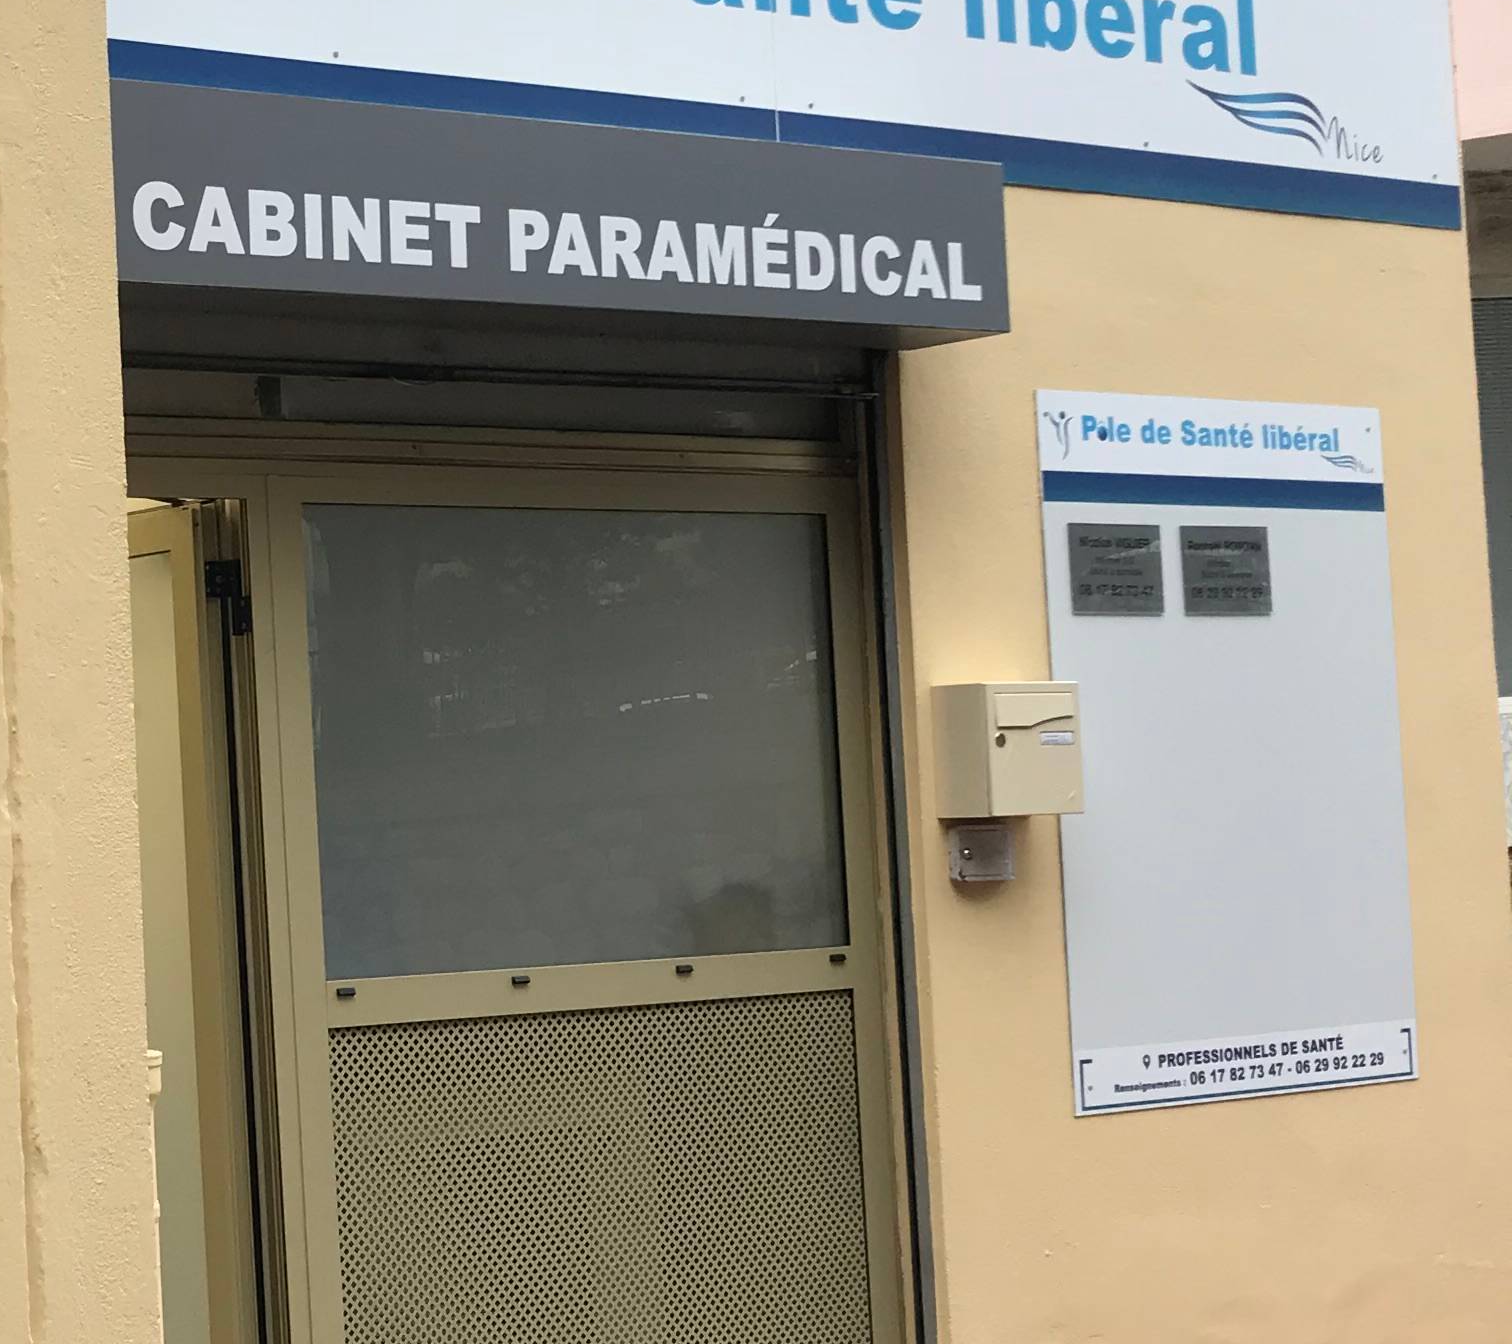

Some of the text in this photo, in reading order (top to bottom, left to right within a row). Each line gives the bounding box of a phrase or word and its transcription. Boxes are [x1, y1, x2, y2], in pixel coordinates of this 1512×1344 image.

[1327, 115, 1384, 164] Nice
[132, 180, 983, 302] CABINET PARAMÉDICAL
[1081, 415, 1339, 453] Pôle de Santé libéral
[1158, 1034, 1344, 1068] PROFESSIONNELS DE SANTÉ
[1190, 1070, 1206, 1085] 06
[1210, 1068, 1225, 1083] 17
[1230, 1067, 1245, 1081] 82
[1249, 1065, 1265, 1079] 73
[1268, 1063, 1283, 1077] 47
[1295, 1060, 1310, 1074] 06
[1314, 1058, 1329, 1072] 29
[1333, 1055, 1348, 1070] 92
[1351, 1054, 1366, 1068] 22
[1369, 1051, 1384, 1066] 29
